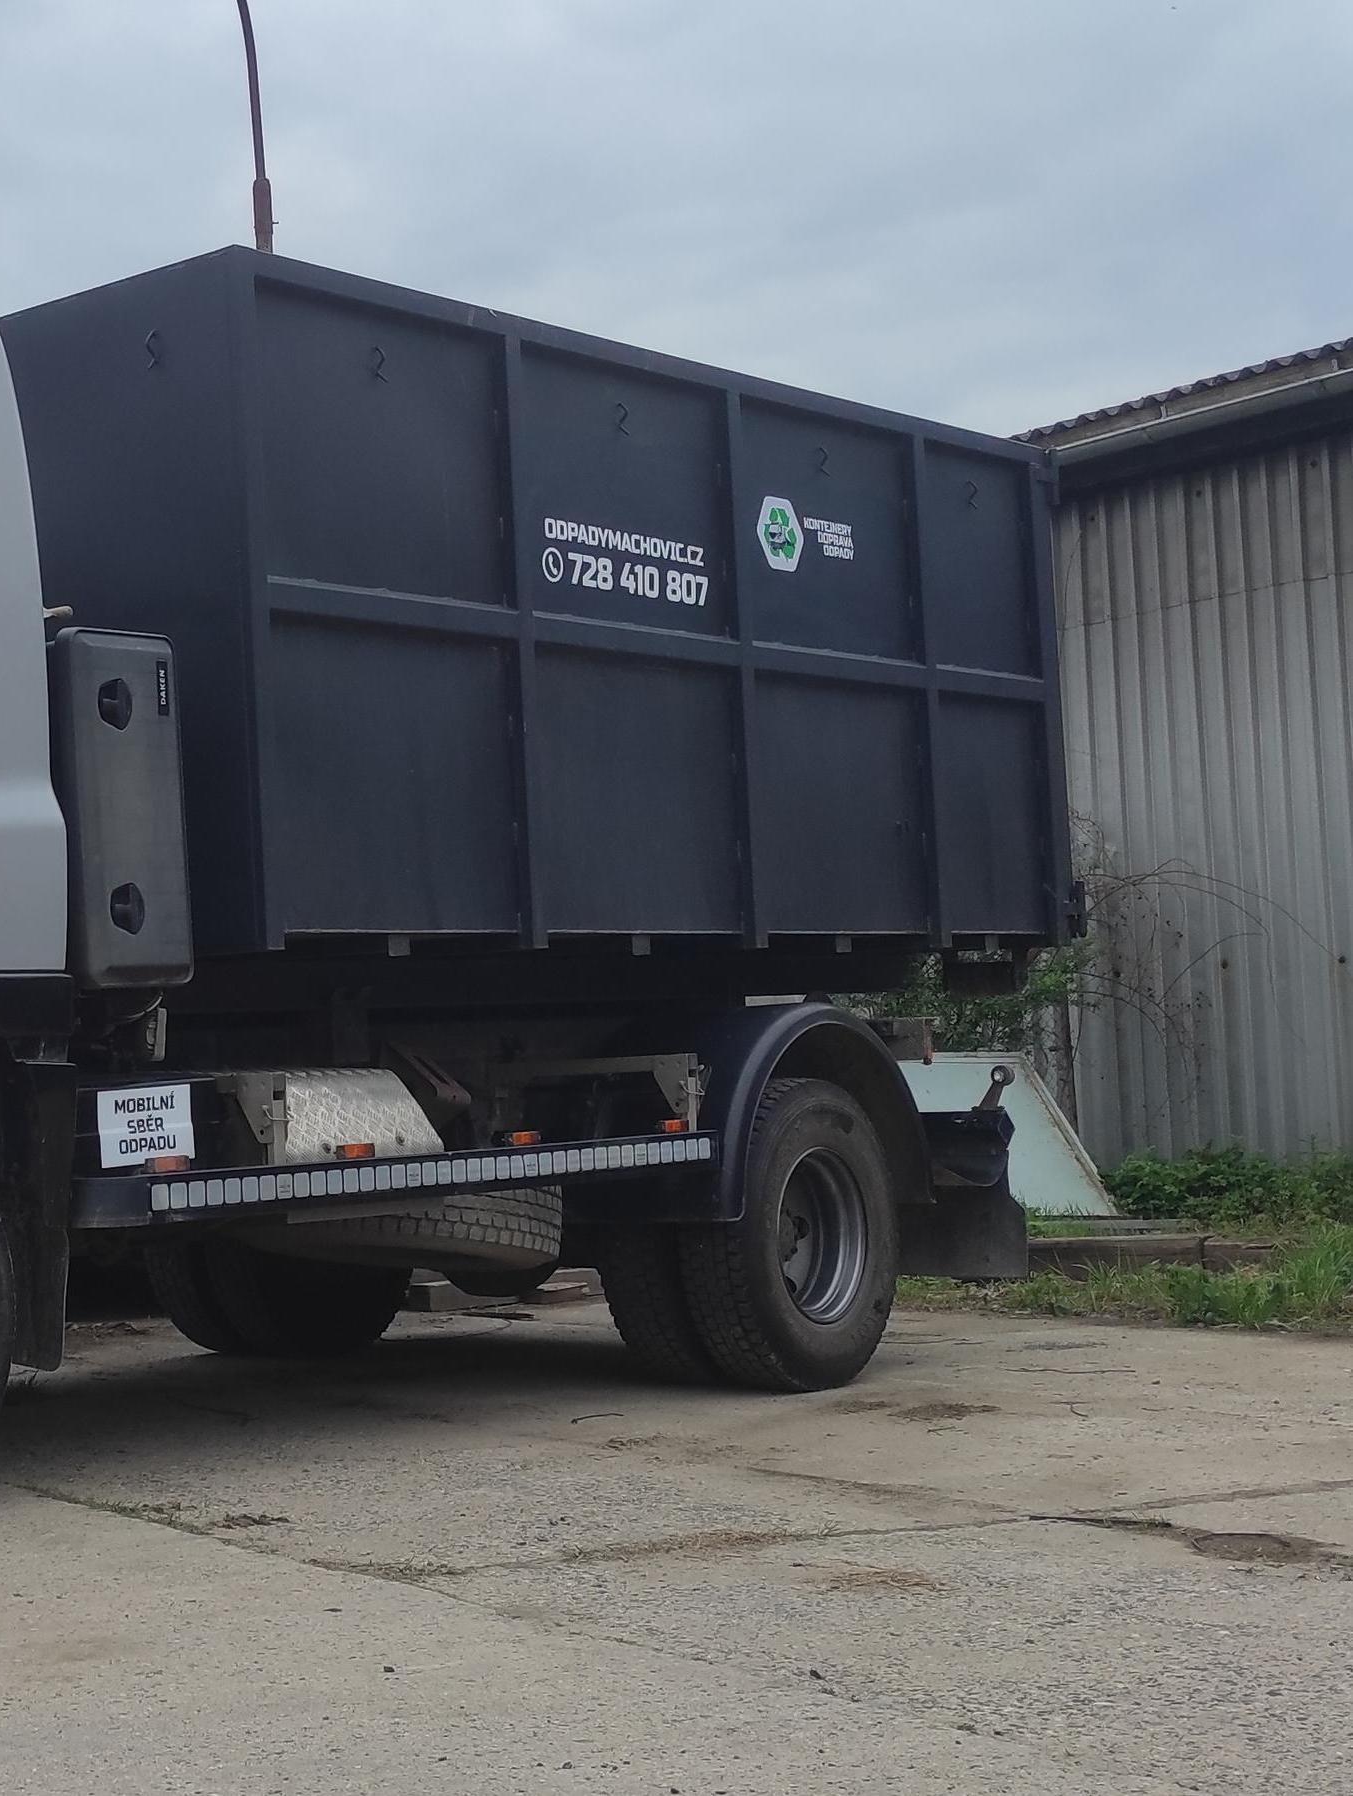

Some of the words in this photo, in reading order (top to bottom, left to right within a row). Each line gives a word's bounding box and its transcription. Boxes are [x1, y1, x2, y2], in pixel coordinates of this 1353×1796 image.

[803, 516, 852, 537] KONTEJNERY
[544, 517, 704, 567] ODPADYMACHOVIC.CZ
[817, 531, 854, 549] DOPRAVA
[823, 545, 854, 561] ODPADY
[568, 552, 613, 591] 728
[619, 562, 660, 599] 410
[666, 571, 708, 606] 807
[158, 669, 167, 705] DAKEN
[114, 1090, 176, 1115] MOBILNÍ
[127, 1114, 165, 1135] SBĚR
[119, 1134, 177, 1155] ODPADU
